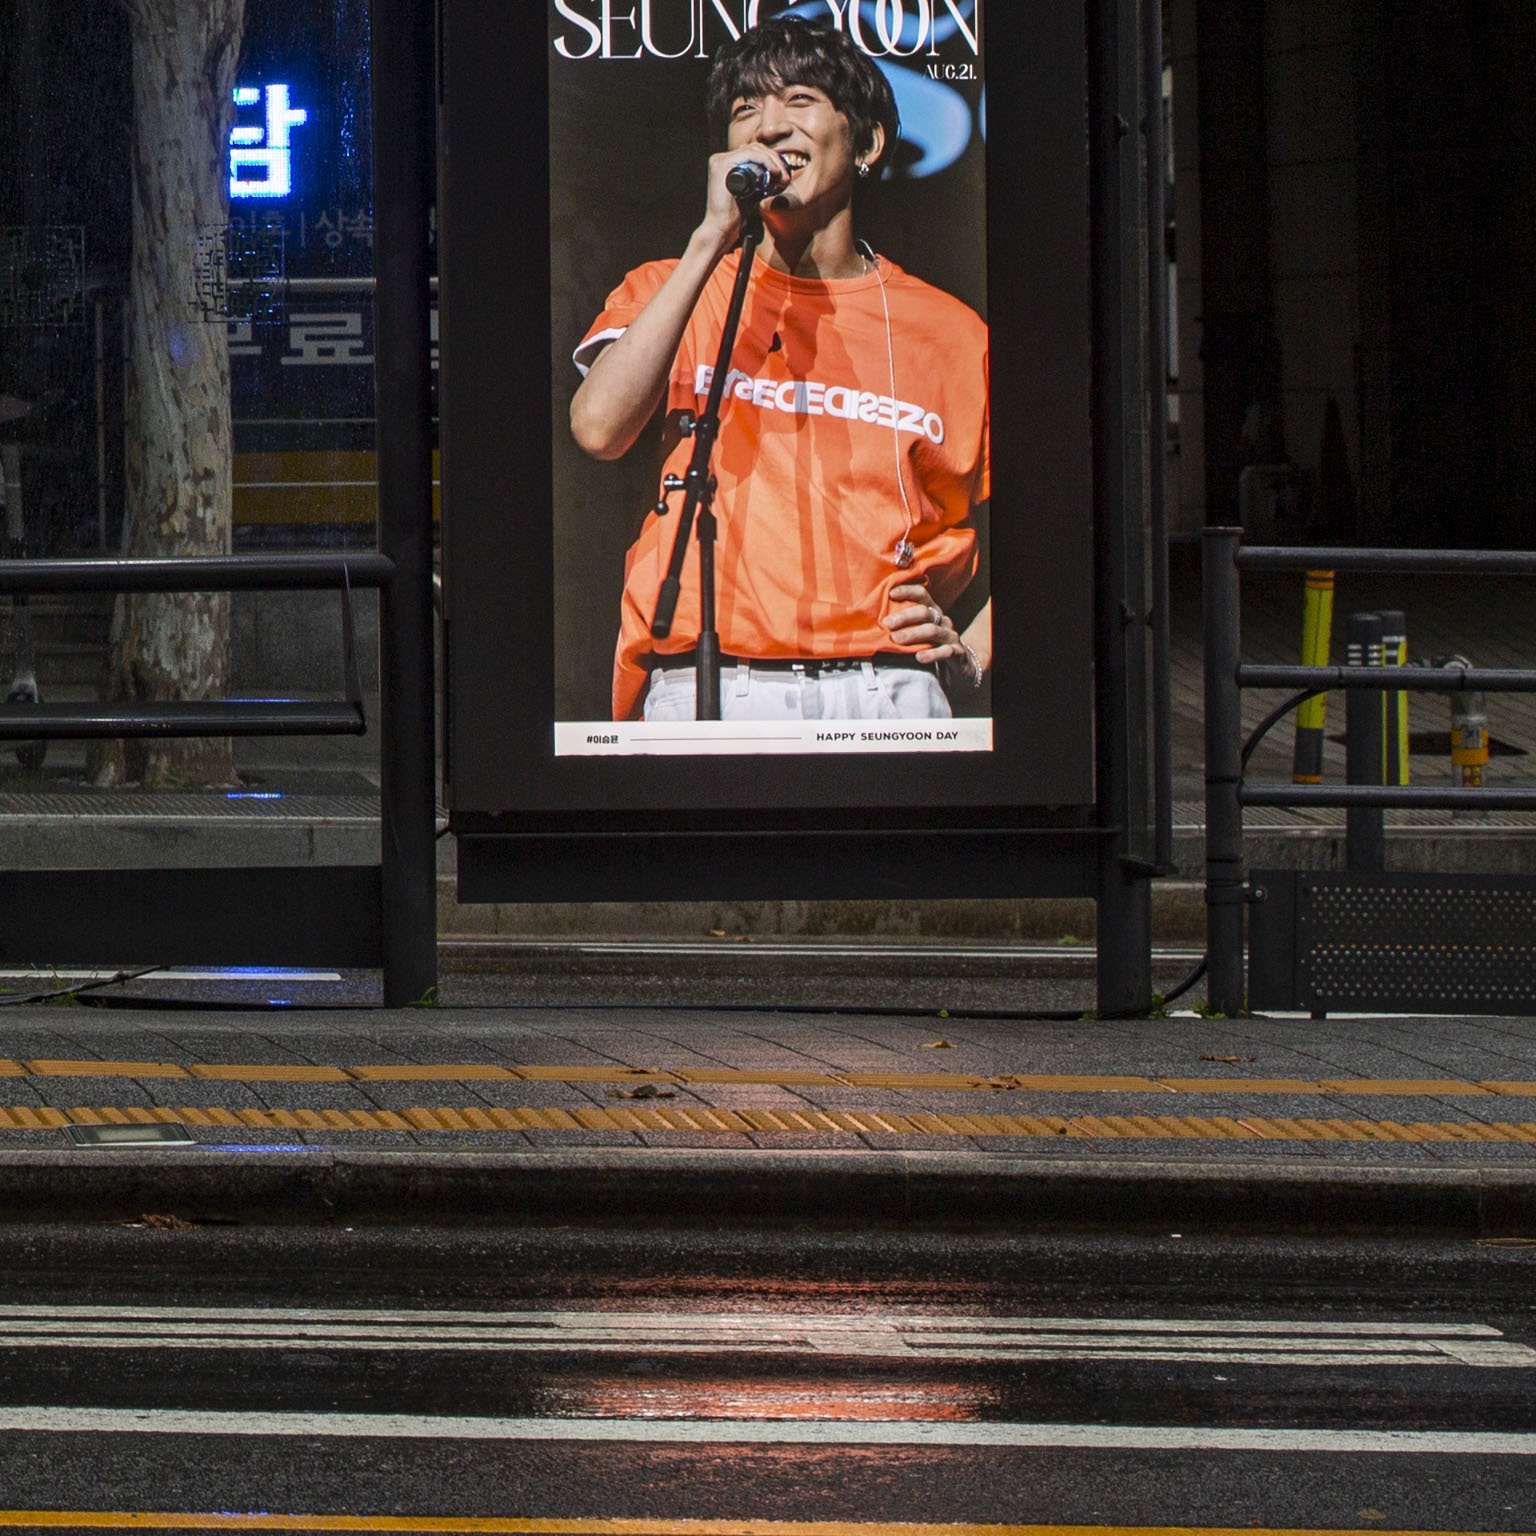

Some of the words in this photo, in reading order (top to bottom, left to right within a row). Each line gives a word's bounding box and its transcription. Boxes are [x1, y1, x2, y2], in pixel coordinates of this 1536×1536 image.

[816, 731, 856, 742] HAPPY
[860, 730, 932, 741] SEUNGYOON
[936, 730, 959, 741] DAY
